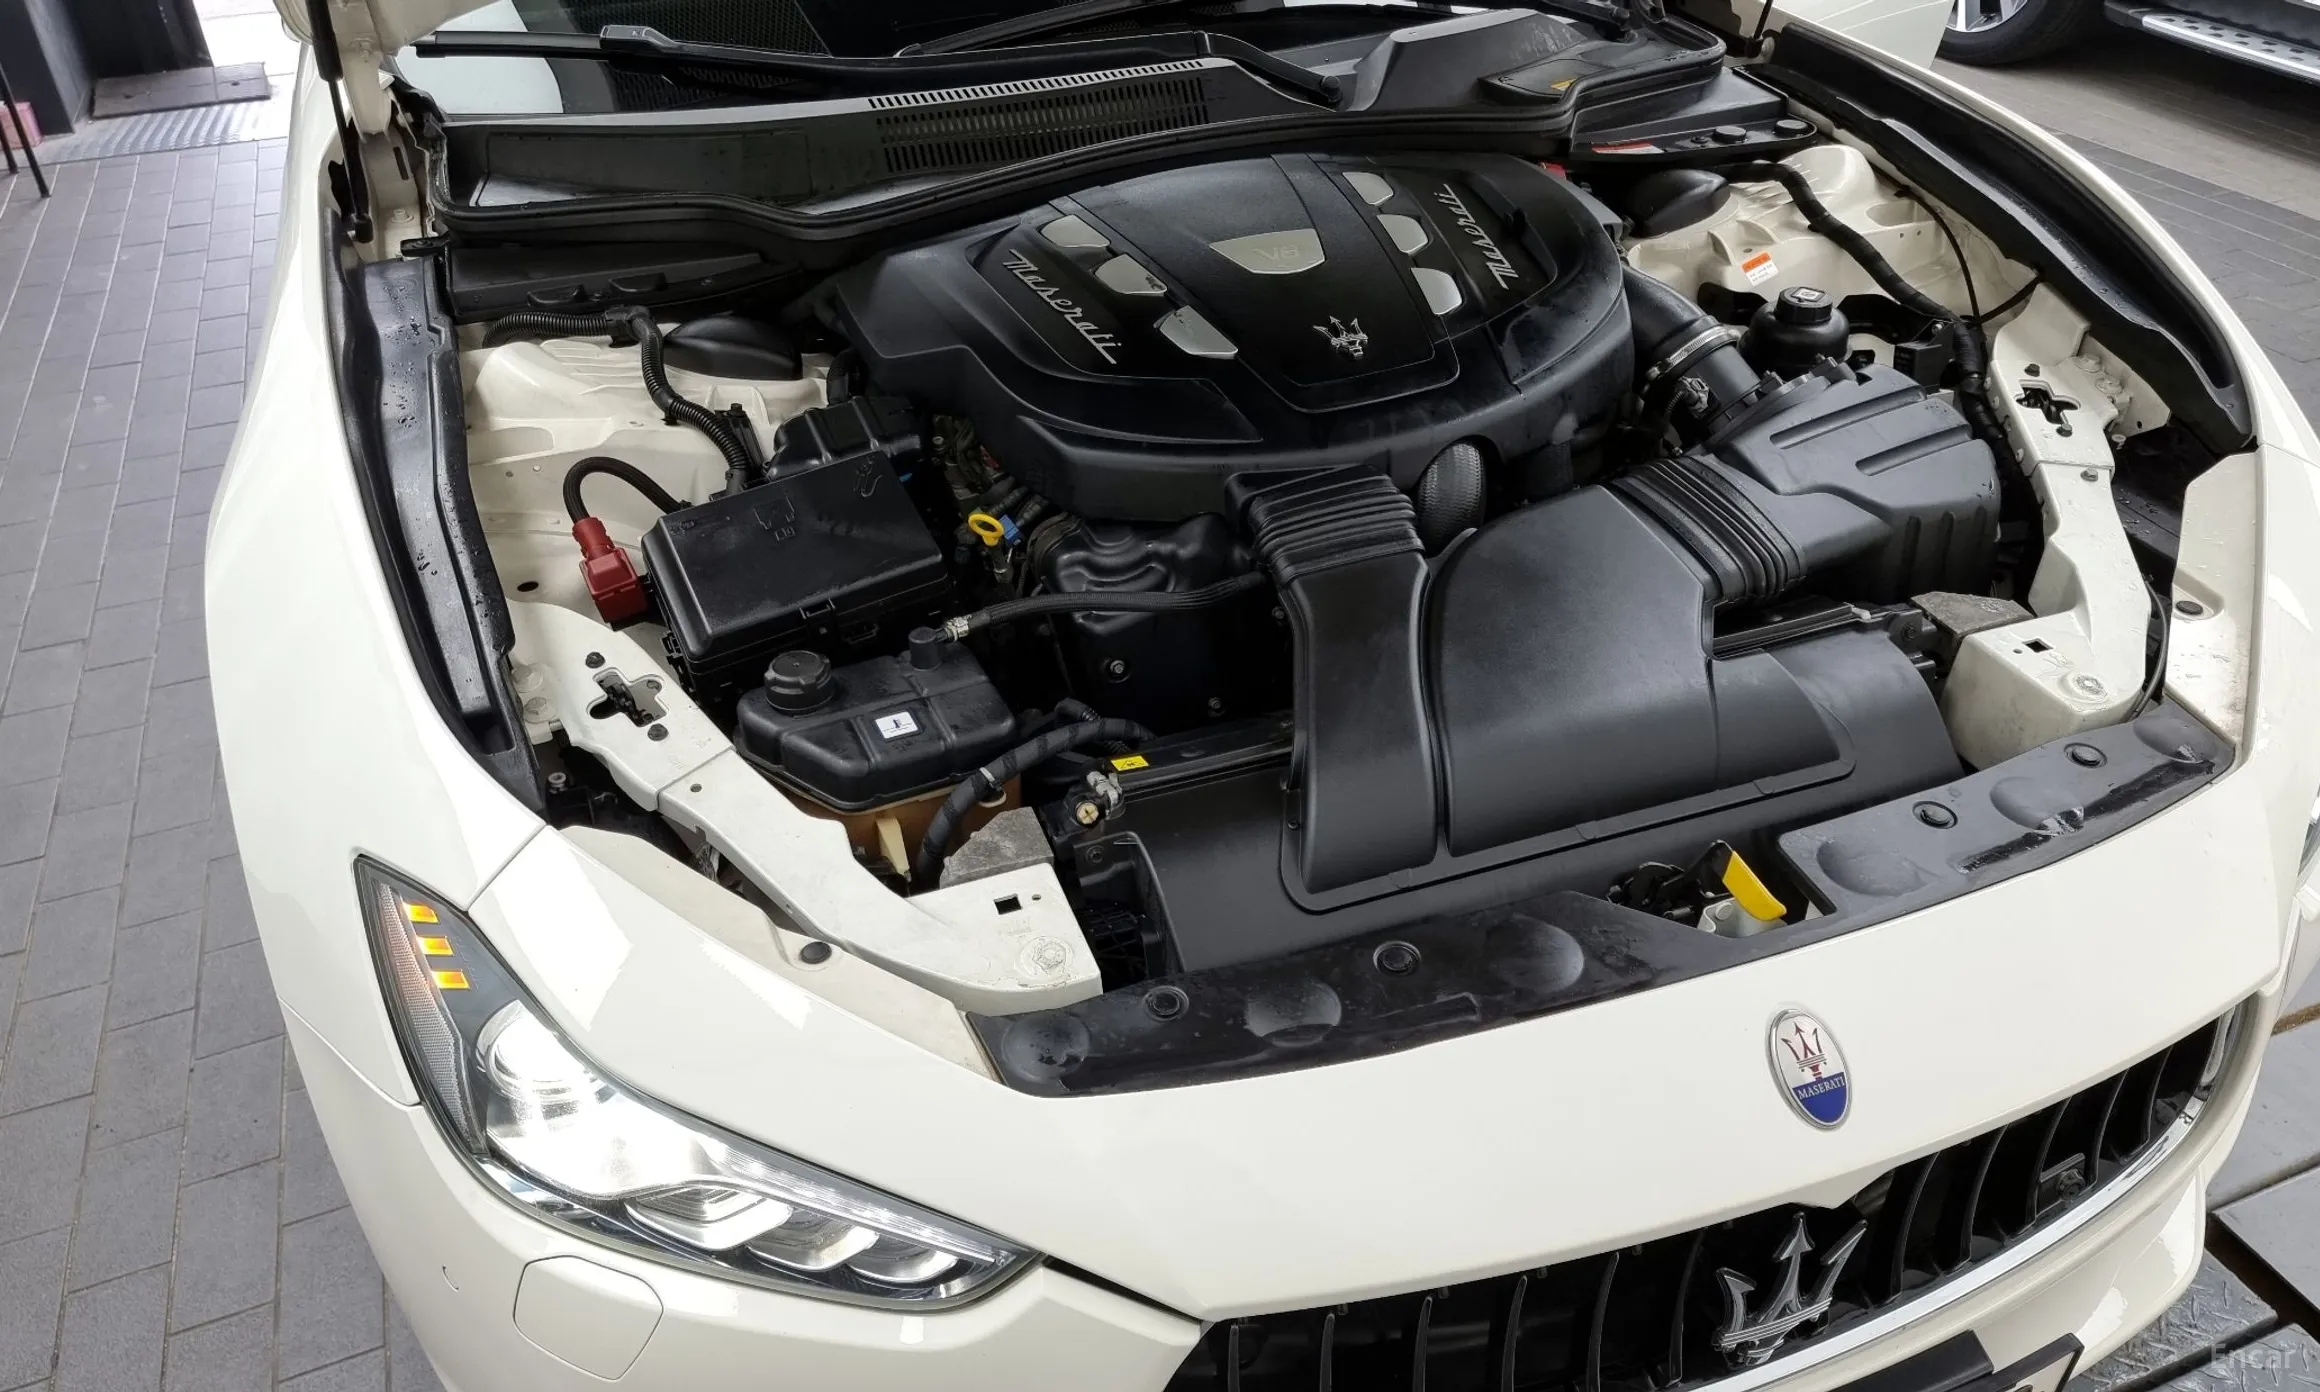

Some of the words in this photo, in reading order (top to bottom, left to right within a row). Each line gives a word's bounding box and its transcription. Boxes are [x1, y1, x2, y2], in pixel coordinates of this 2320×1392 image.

[1433, 183, 1519, 290] Maserati
[1003, 248, 1122, 364] Maserati
[1797, 1076, 1845, 1100] MASERATI
